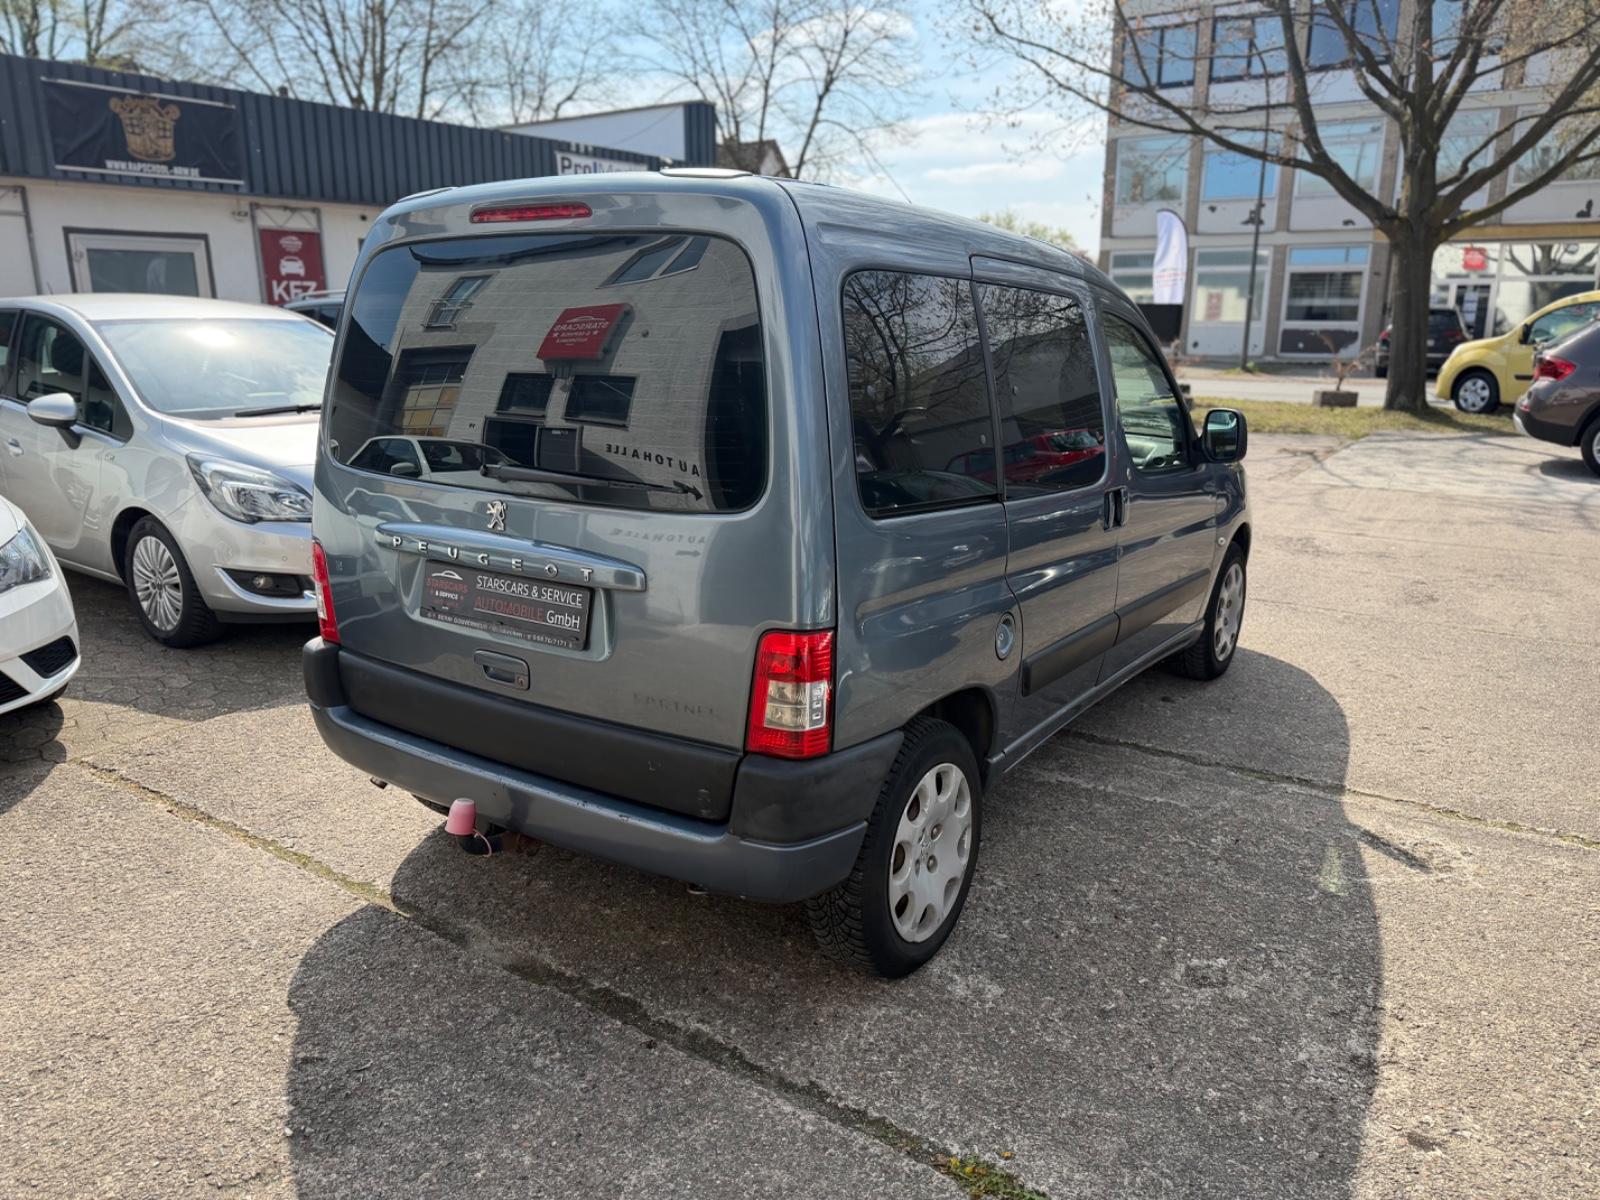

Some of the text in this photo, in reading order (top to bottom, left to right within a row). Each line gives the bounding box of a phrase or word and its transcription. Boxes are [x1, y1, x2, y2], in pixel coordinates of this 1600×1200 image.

[271, 279, 318, 302] KFZ
[392, 535, 594, 583] PEUGEOT
[476, 574, 583, 606] STARSCARS & SERVICE
[474, 595, 545, 622] AUTOMOBILE
[546, 610, 581, 629] GmbH
